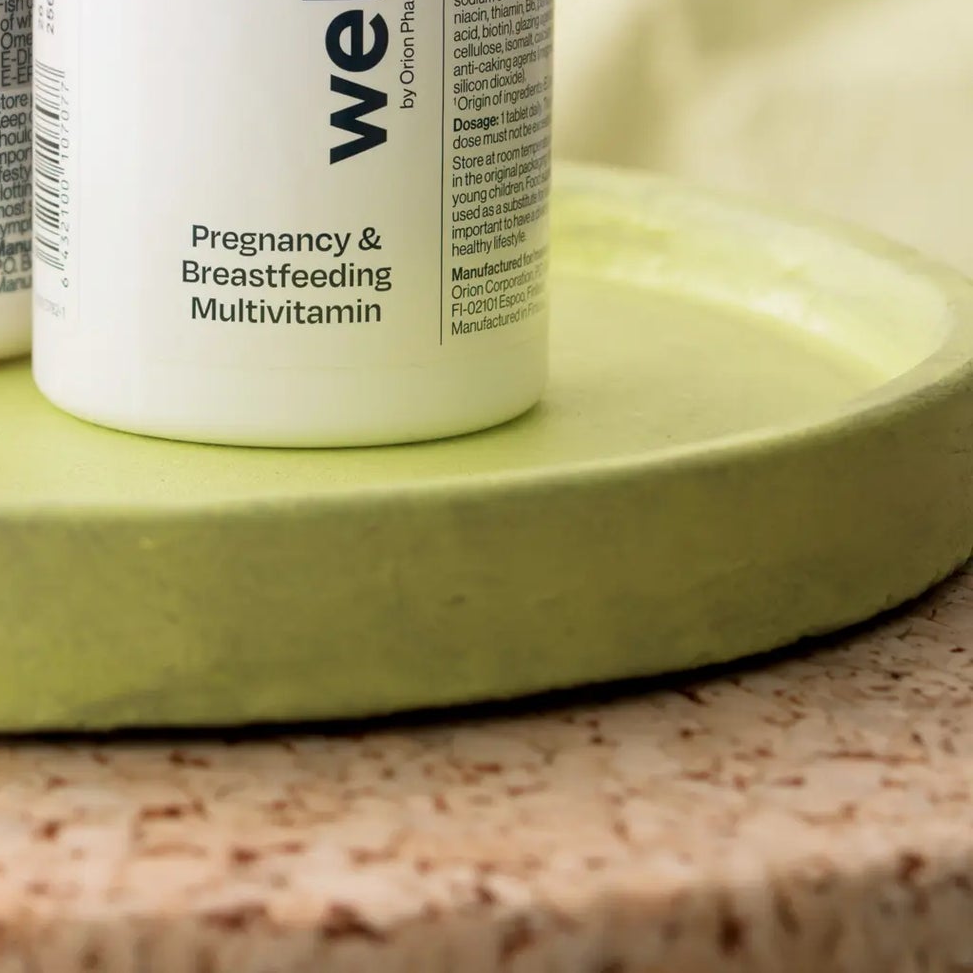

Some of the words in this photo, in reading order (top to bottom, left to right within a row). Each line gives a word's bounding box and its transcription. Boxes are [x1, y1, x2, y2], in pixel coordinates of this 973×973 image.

[0, 13, 15, 32] of
[454, 7, 490, 24] niacin,
[453, 25, 480, 41] acid,
[400, 36, 415, 85] Orion
[453, 42, 504, 59] cellulose,
[453, 56, 511, 77] anti-caking
[453, 78, 488, 94] silicon
[400, 88, 417, 109] by
[492, 90, 503, 105] of
[453, 115, 500, 132] Dosage:
[453, 135, 482, 149] dose
[483, 129, 507, 145] must
[508, 124, 522, 140] not
[452, 156, 484, 170] Store
[485, 151, 496, 166] at
[497, 147, 520, 163] room
[452, 174, 463, 188] in
[465, 171, 483, 186] the
[484, 162, 518, 184] original
[452, 189, 487, 207] young
[452, 205, 481, 222] used
[482, 206, 494, 217] as
[495, 204, 502, 215] a
[452, 217, 503, 240] important
[504, 217, 513, 230] to
[192, 224, 351, 257] Pregnancy
[358, 227, 382, 250] &
[452, 238, 492, 257] healthy
[182, 260, 392, 291] Breastfeeding
[452, 254, 522, 281] Manufactured
[452, 284, 483, 299] Orion
[191, 296, 381, 324] Multivitamin
[452, 296, 498, 317] FI-02101
[452, 308, 520, 335] Manufactured
